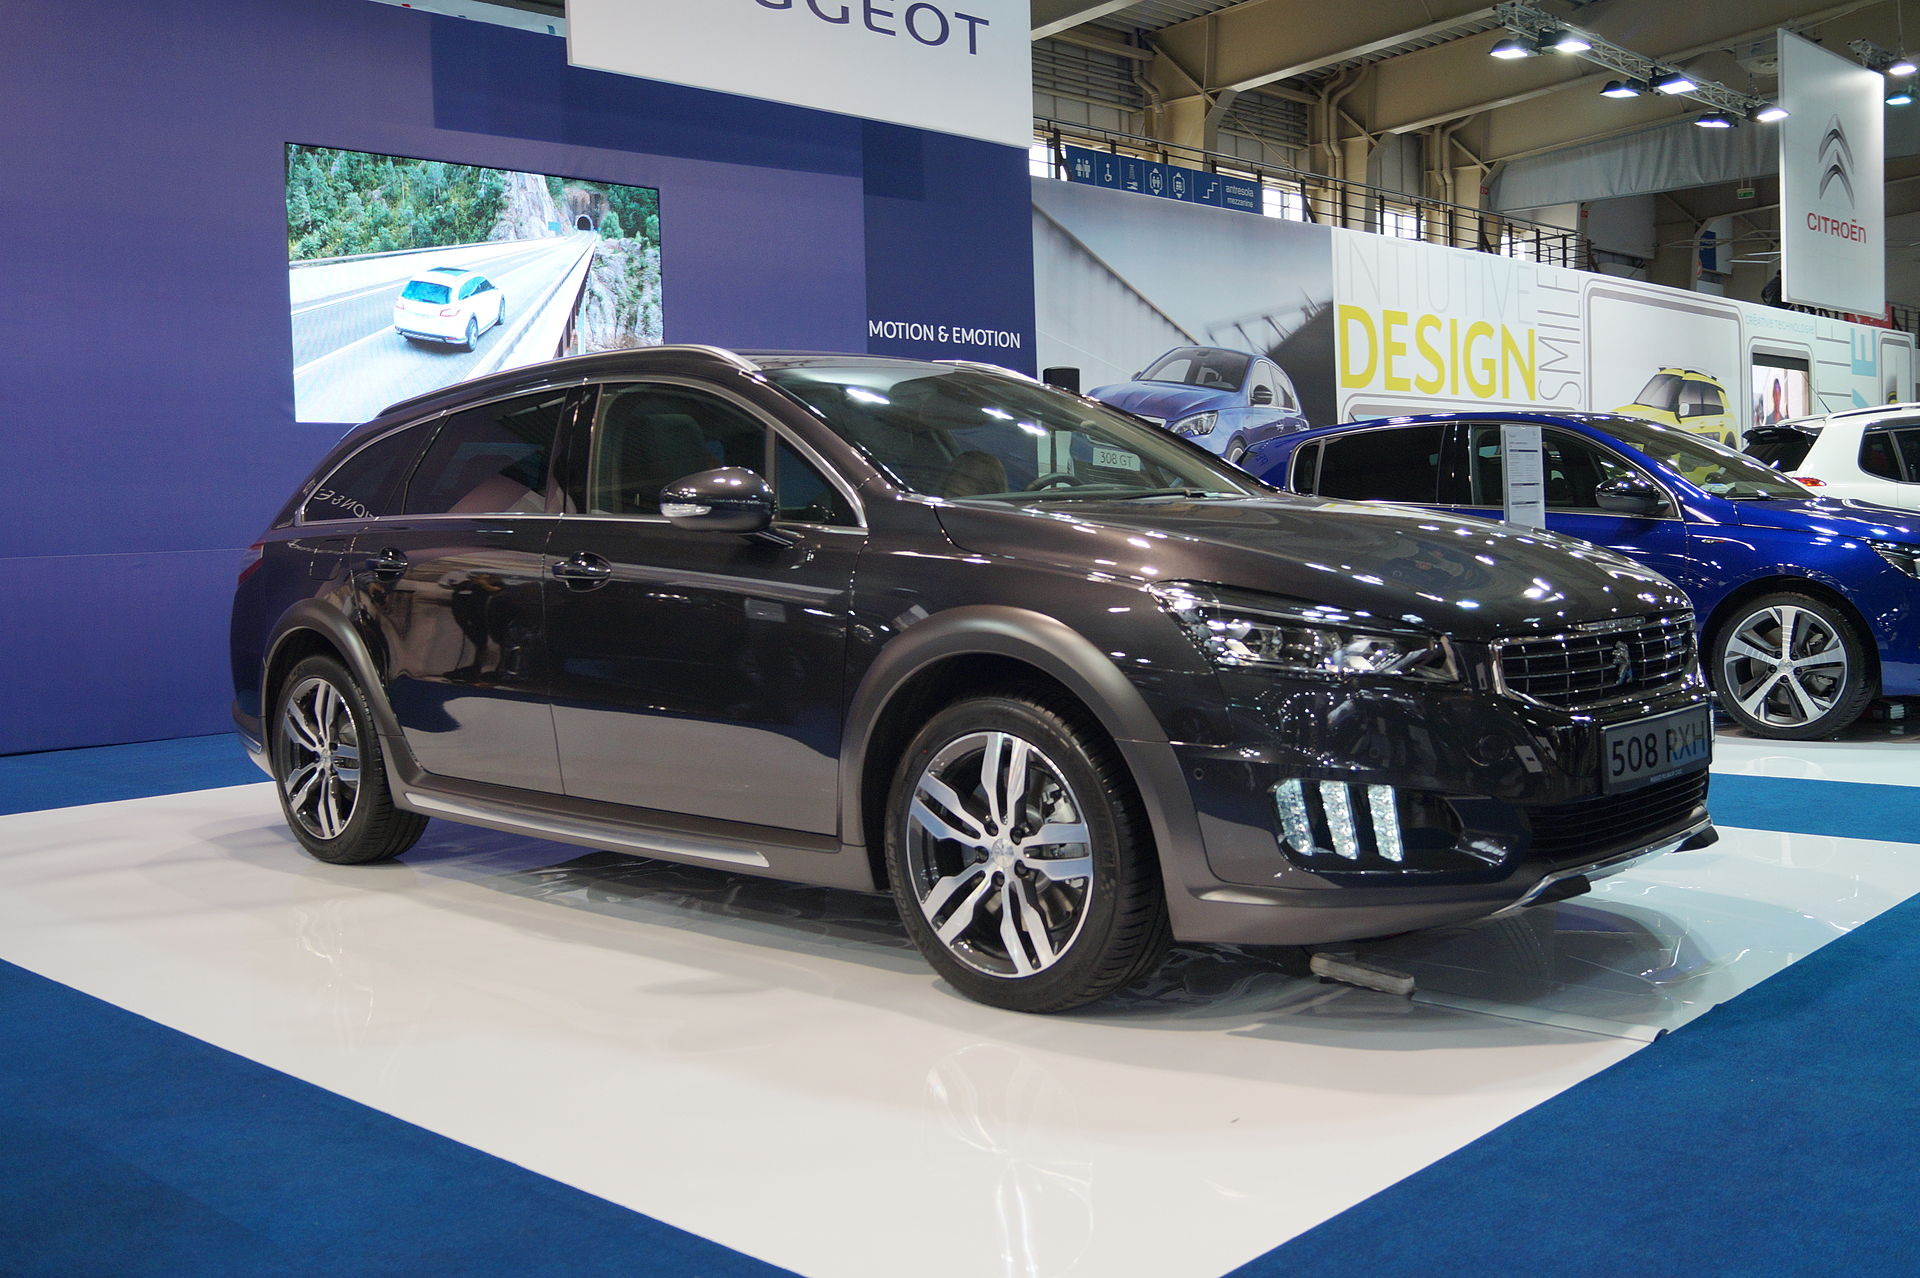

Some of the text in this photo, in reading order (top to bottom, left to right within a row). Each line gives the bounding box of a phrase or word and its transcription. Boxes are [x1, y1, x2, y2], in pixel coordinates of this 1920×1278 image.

[755, 0, 990, 55] GEOT
[868, 320, 1021, 349] MOTION & EMOTION
[1338, 303, 1537, 402] DESIGN
[1536, 267, 1582, 405] SMILE
[1100, 451, 1133, 468] 308 GT
[1612, 721, 1706, 777] 508 RXH
